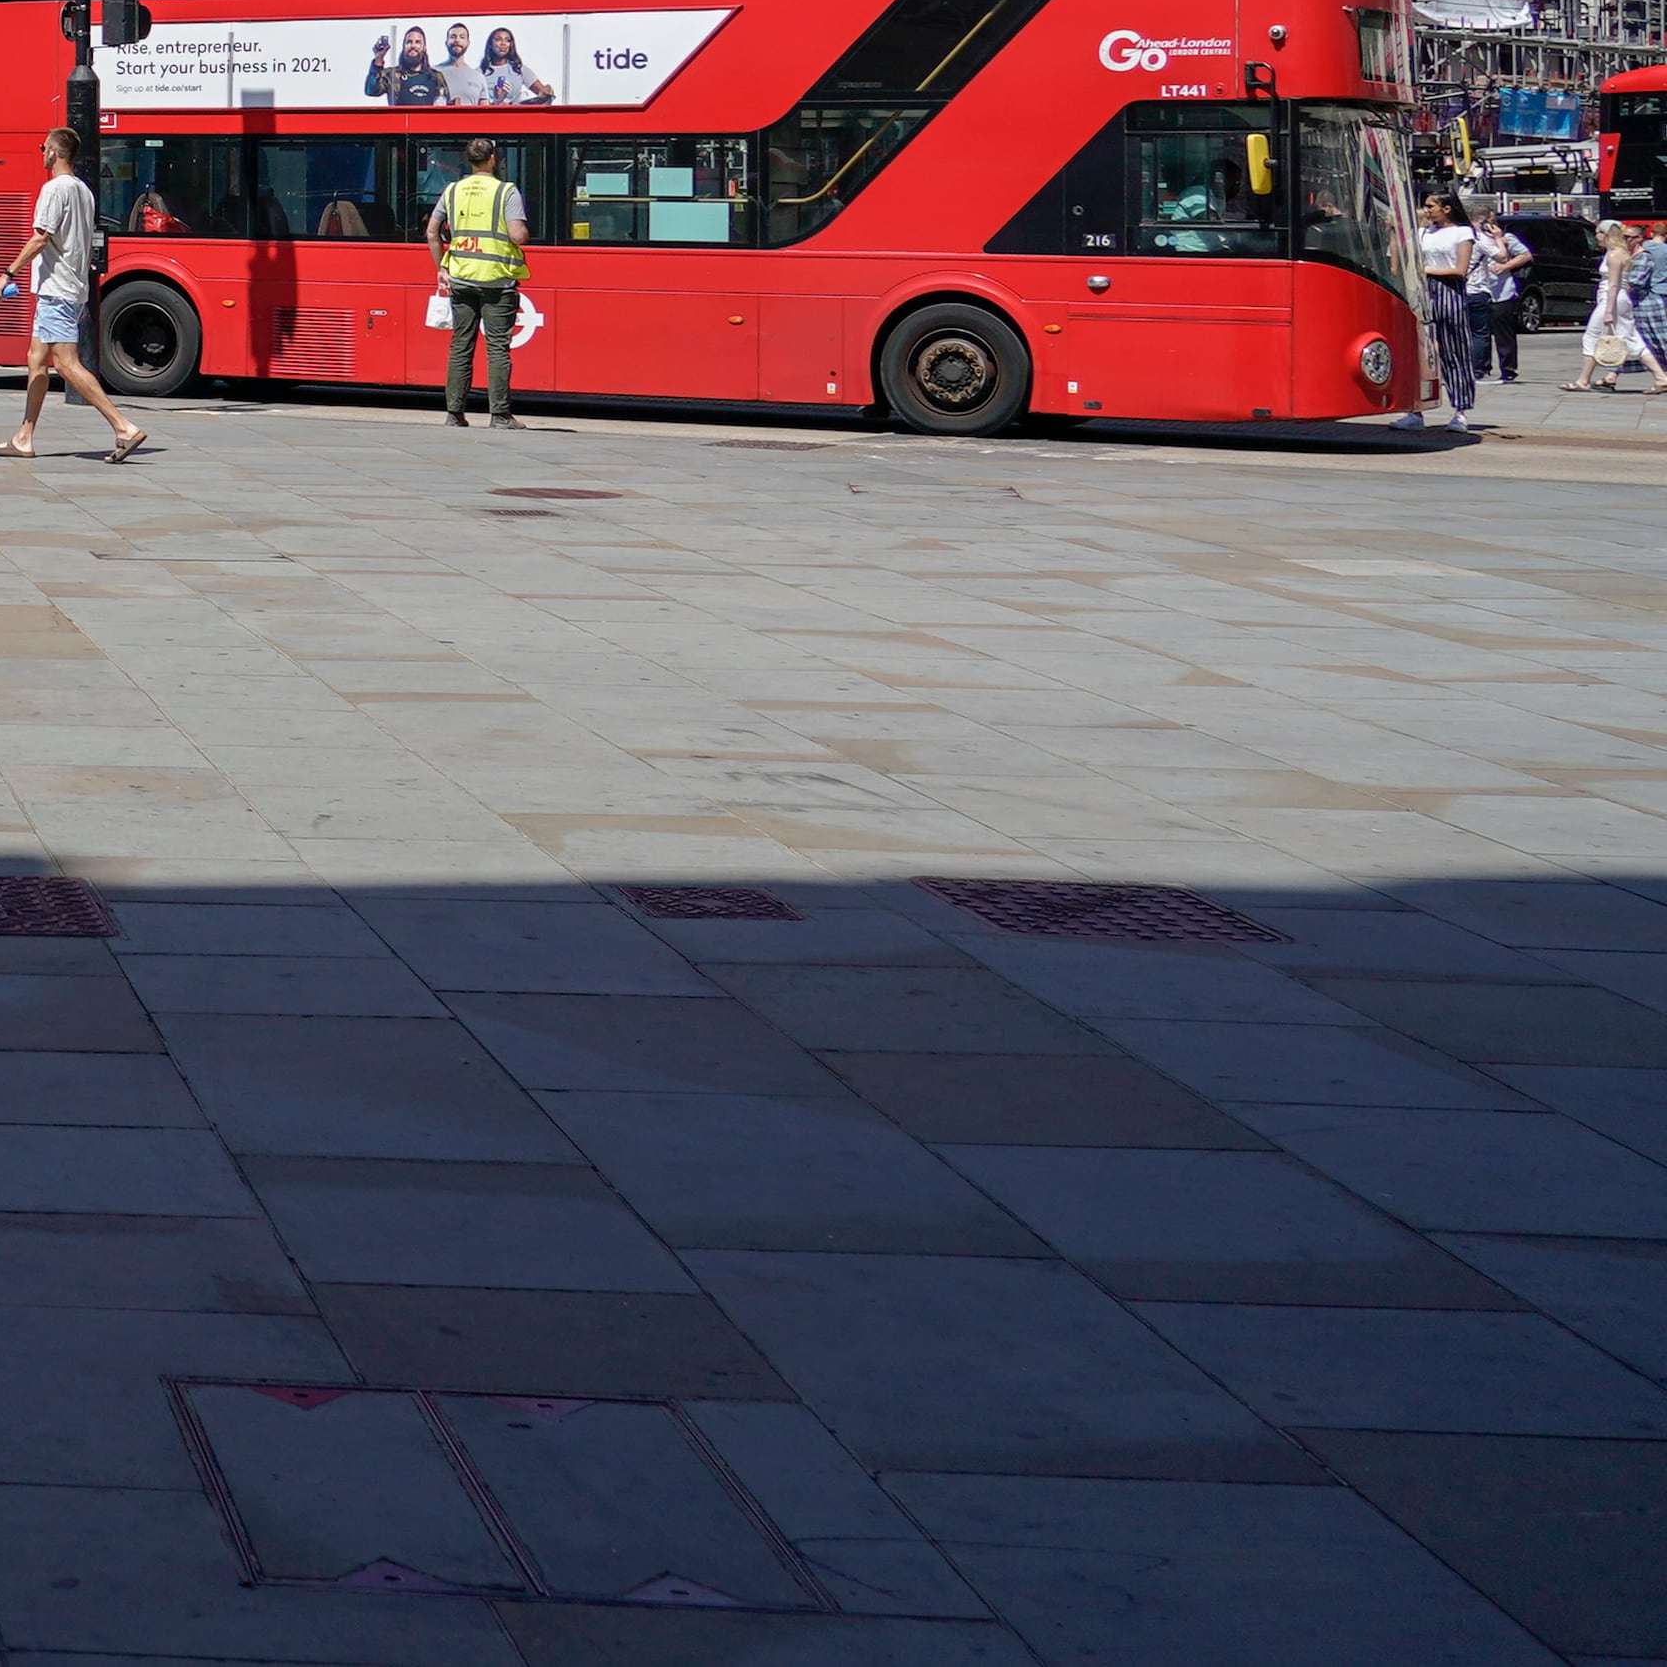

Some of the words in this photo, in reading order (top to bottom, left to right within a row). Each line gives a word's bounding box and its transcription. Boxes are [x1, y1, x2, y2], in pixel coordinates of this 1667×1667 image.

[156, 40, 262, 57] entrepreneur.
[1099, 29, 1167, 72] Go
[593, 44, 649, 72] tide
[116, 60, 155, 75] Start
[160, 63, 195, 78] your
[199, 59, 268, 75] business
[272, 58, 287, 73] in
[291, 57, 332, 73] 2021.
[116, 84, 133, 93] Sign
[134, 85, 144, 93] up
[146, 84, 154, 92] at
[155, 83, 203, 93] tide.co/start
[1160, 84, 1207, 97] LT441
[1086, 234, 1111, 247] 216
